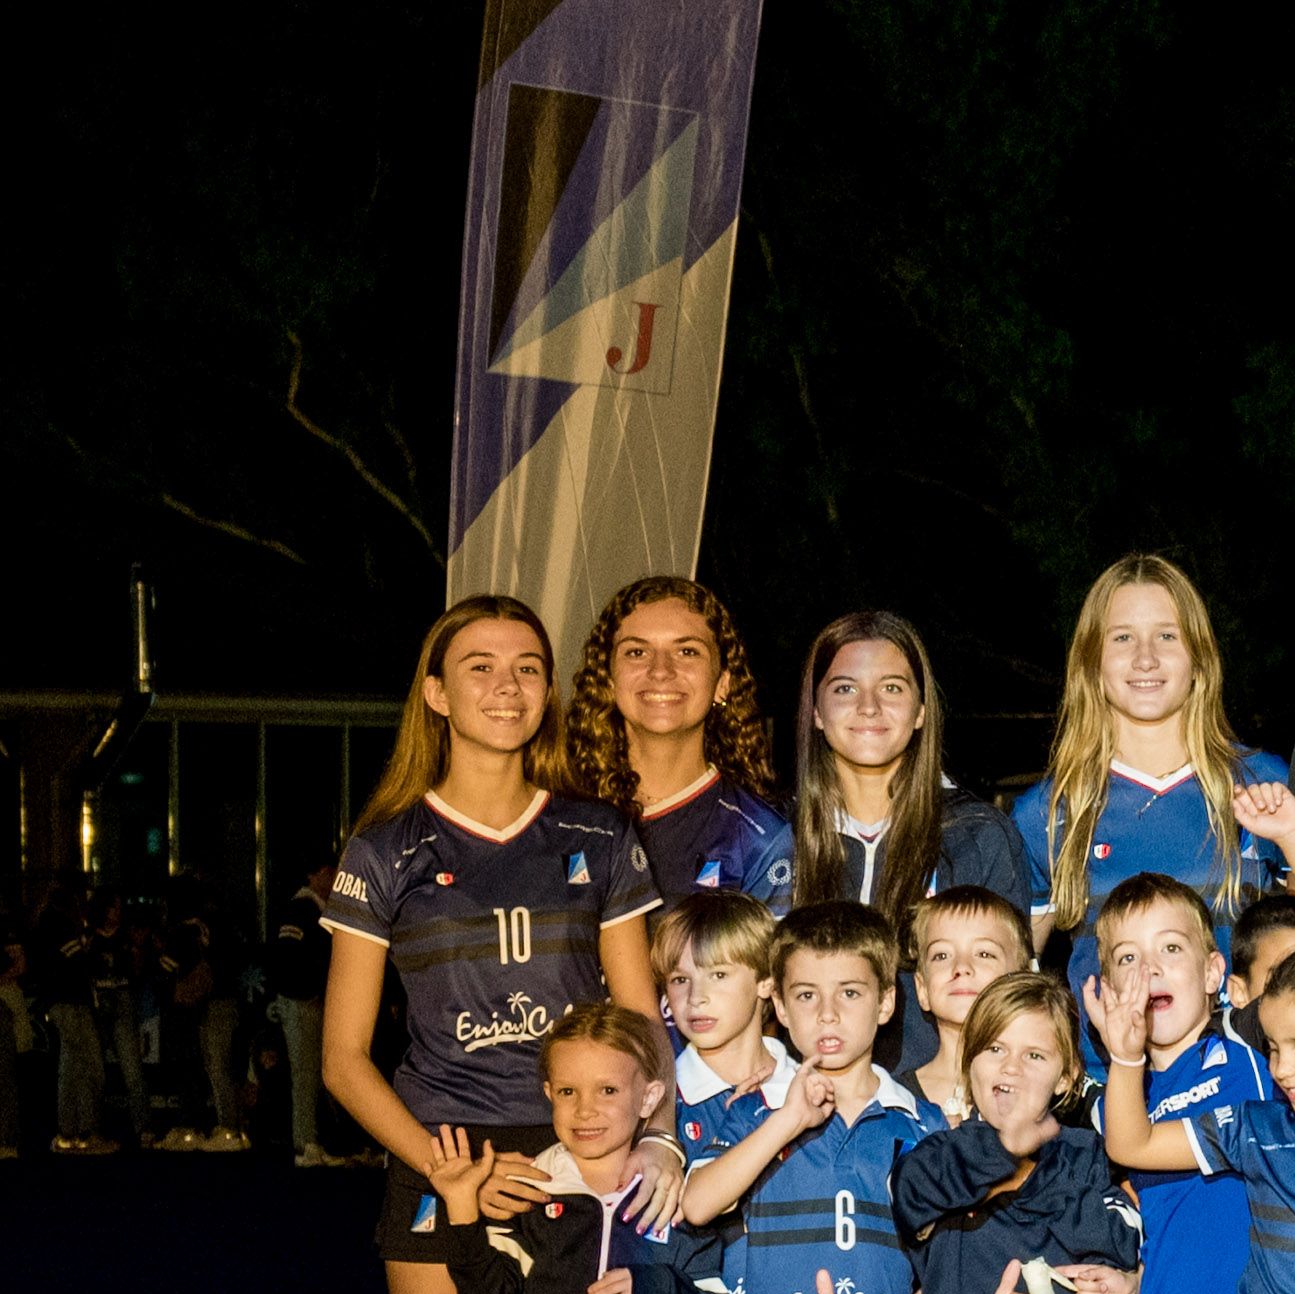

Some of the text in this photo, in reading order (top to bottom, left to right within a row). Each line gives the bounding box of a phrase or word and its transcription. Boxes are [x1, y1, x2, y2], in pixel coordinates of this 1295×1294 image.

[606, 302, 663, 375] J
[493, 906, 532, 965] 10
[457, 1010, 527, 1045] Enjoy
[1148, 1076, 1221, 1124] TERSPORT
[835, 1189, 856, 1251] 6
